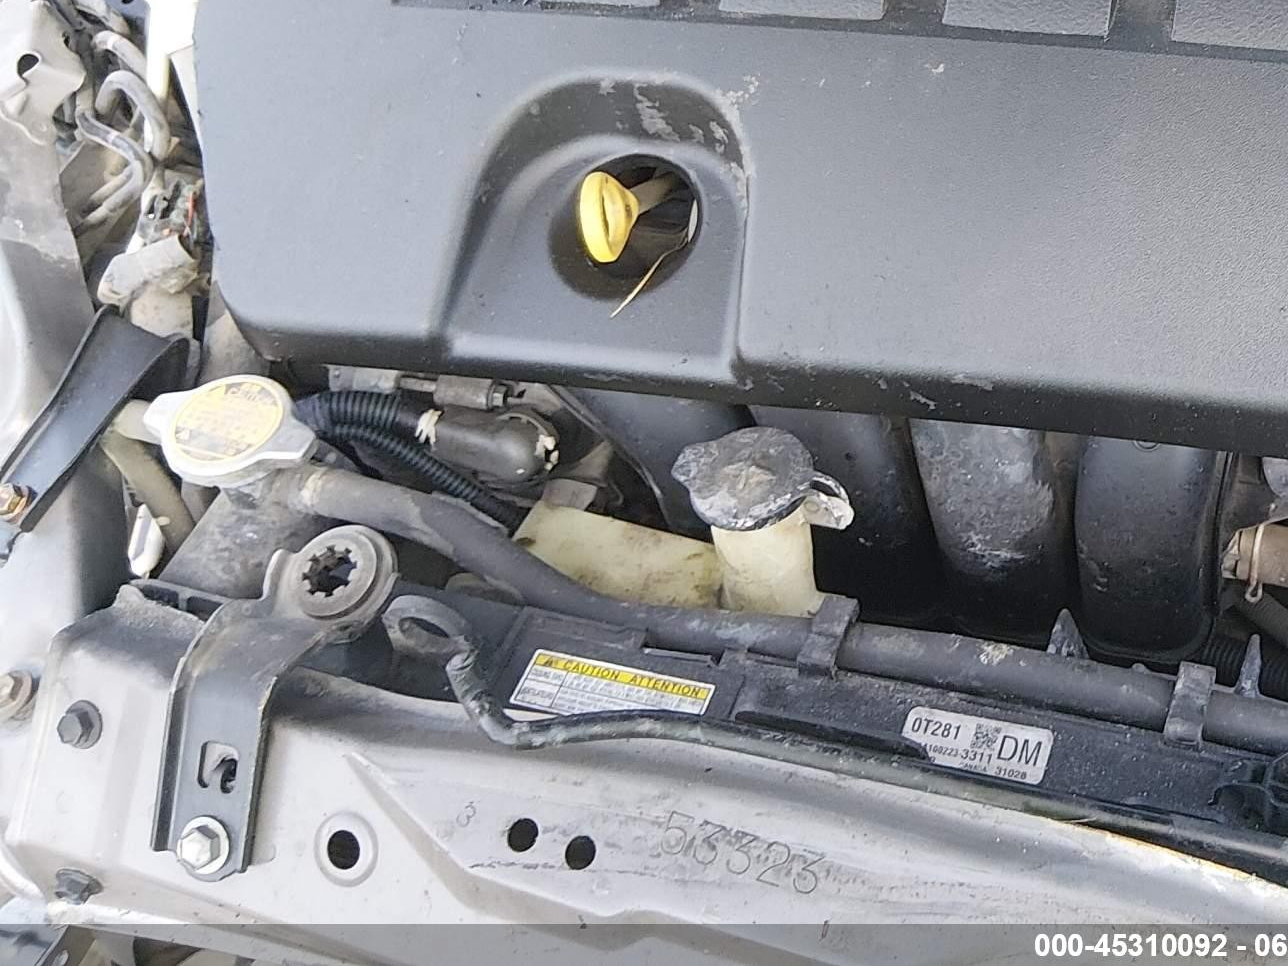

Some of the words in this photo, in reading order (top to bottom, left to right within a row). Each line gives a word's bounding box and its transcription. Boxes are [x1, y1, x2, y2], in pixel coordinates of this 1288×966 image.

[563, 659, 620, 680] CAUTION
[629, 674, 701, 696] ATTENTION
[996, 735, 1043, 767] DM
[660, 810, 826, 895] 53323
